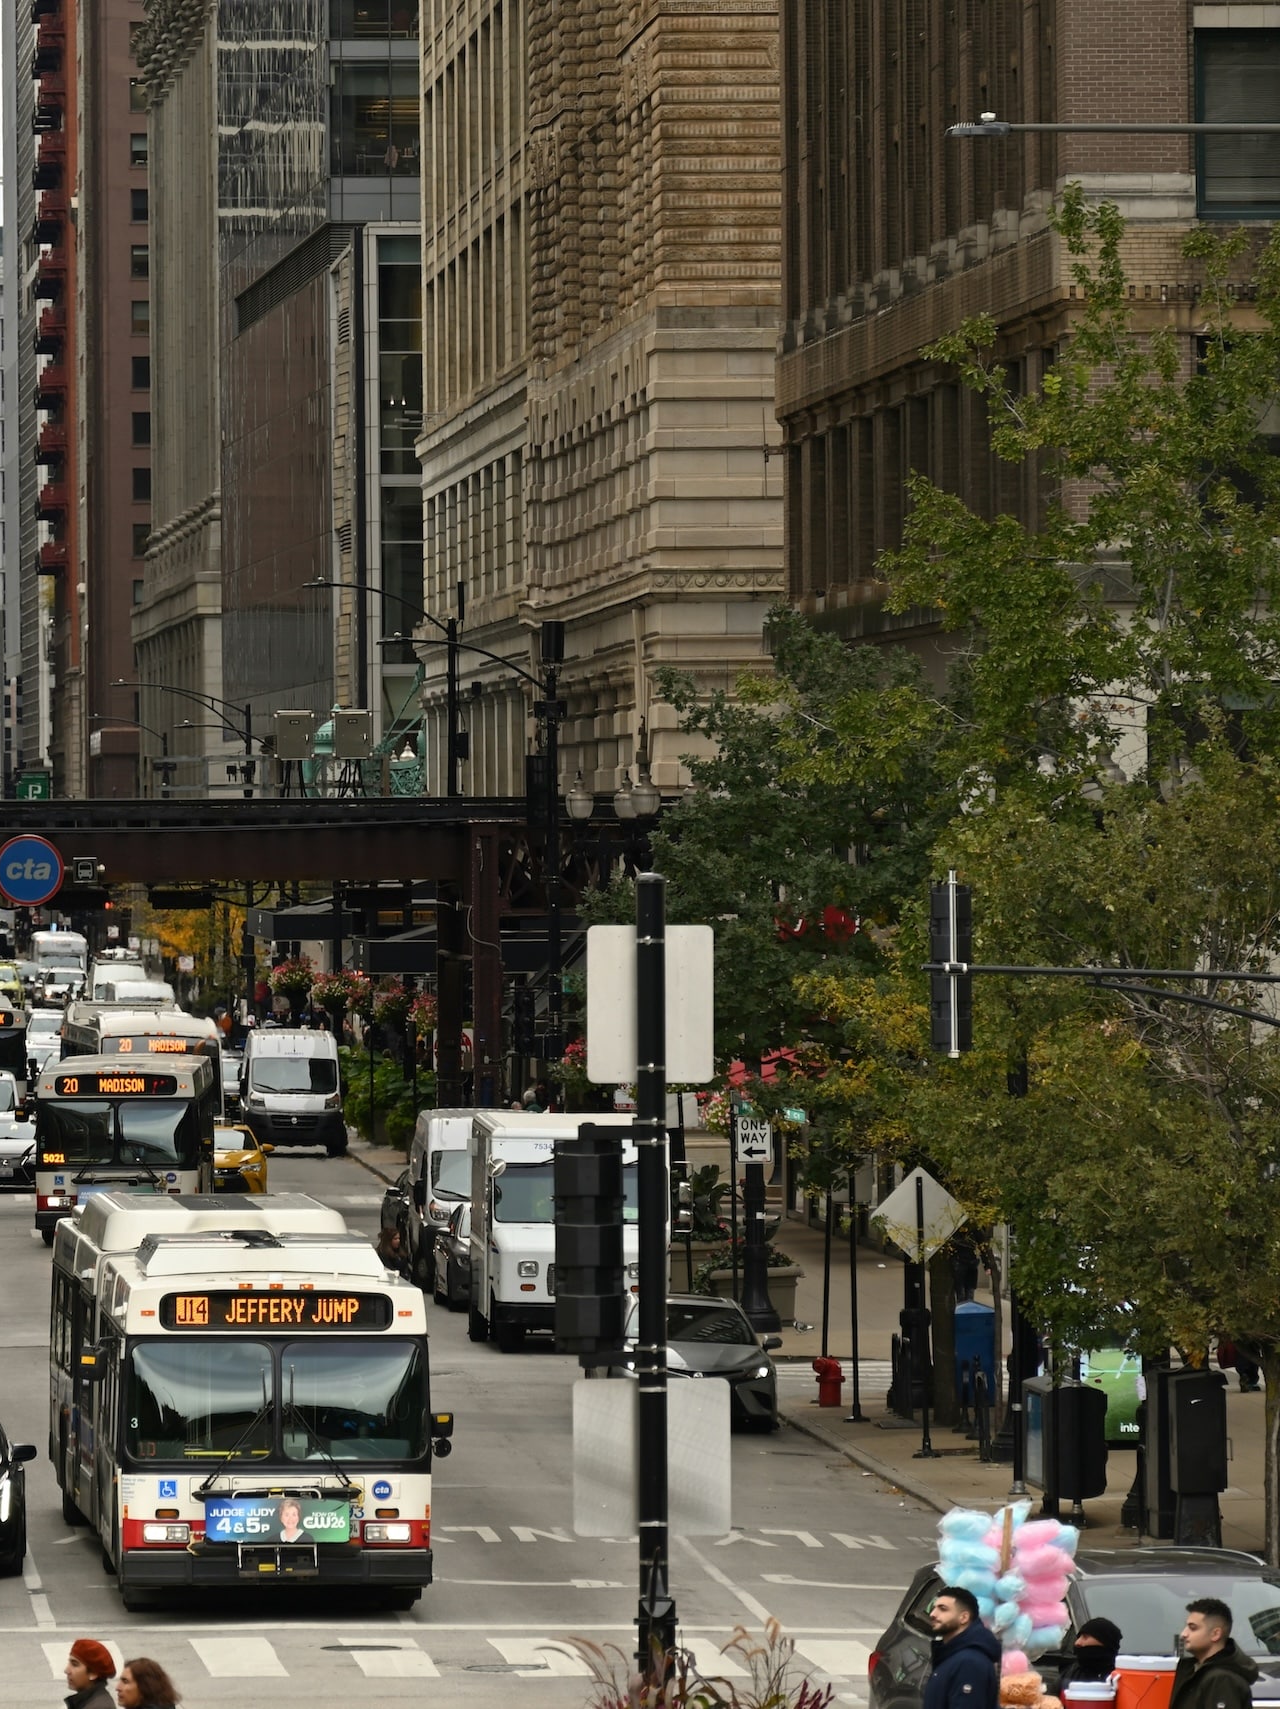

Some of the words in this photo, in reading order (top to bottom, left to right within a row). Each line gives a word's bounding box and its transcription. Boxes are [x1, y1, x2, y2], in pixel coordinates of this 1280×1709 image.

[6, 858, 51, 880] cta
[119, 1038, 132, 1052] 20
[148, 1039, 186, 1052] MADISON
[63, 1078, 78, 1093] 20
[99, 1078, 145, 1093] MADISON
[741, 1119, 767, 1130] ONE
[741, 1132, 767, 1143] WAY
[42, 1153, 65, 1163] 5021
[177, 1297, 208, 1324] J14
[225, 1298, 305, 1323] JEFFERY
[311, 1298, 359, 1323] JUMP
[131, 1417, 138, 1428] 3
[1120, 1422, 1140, 1432] inte
[374, 1486, 389, 1494] cta
[210, 1508, 245, 1518] JUDGE
[247, 1508, 276, 1518] JUDY
